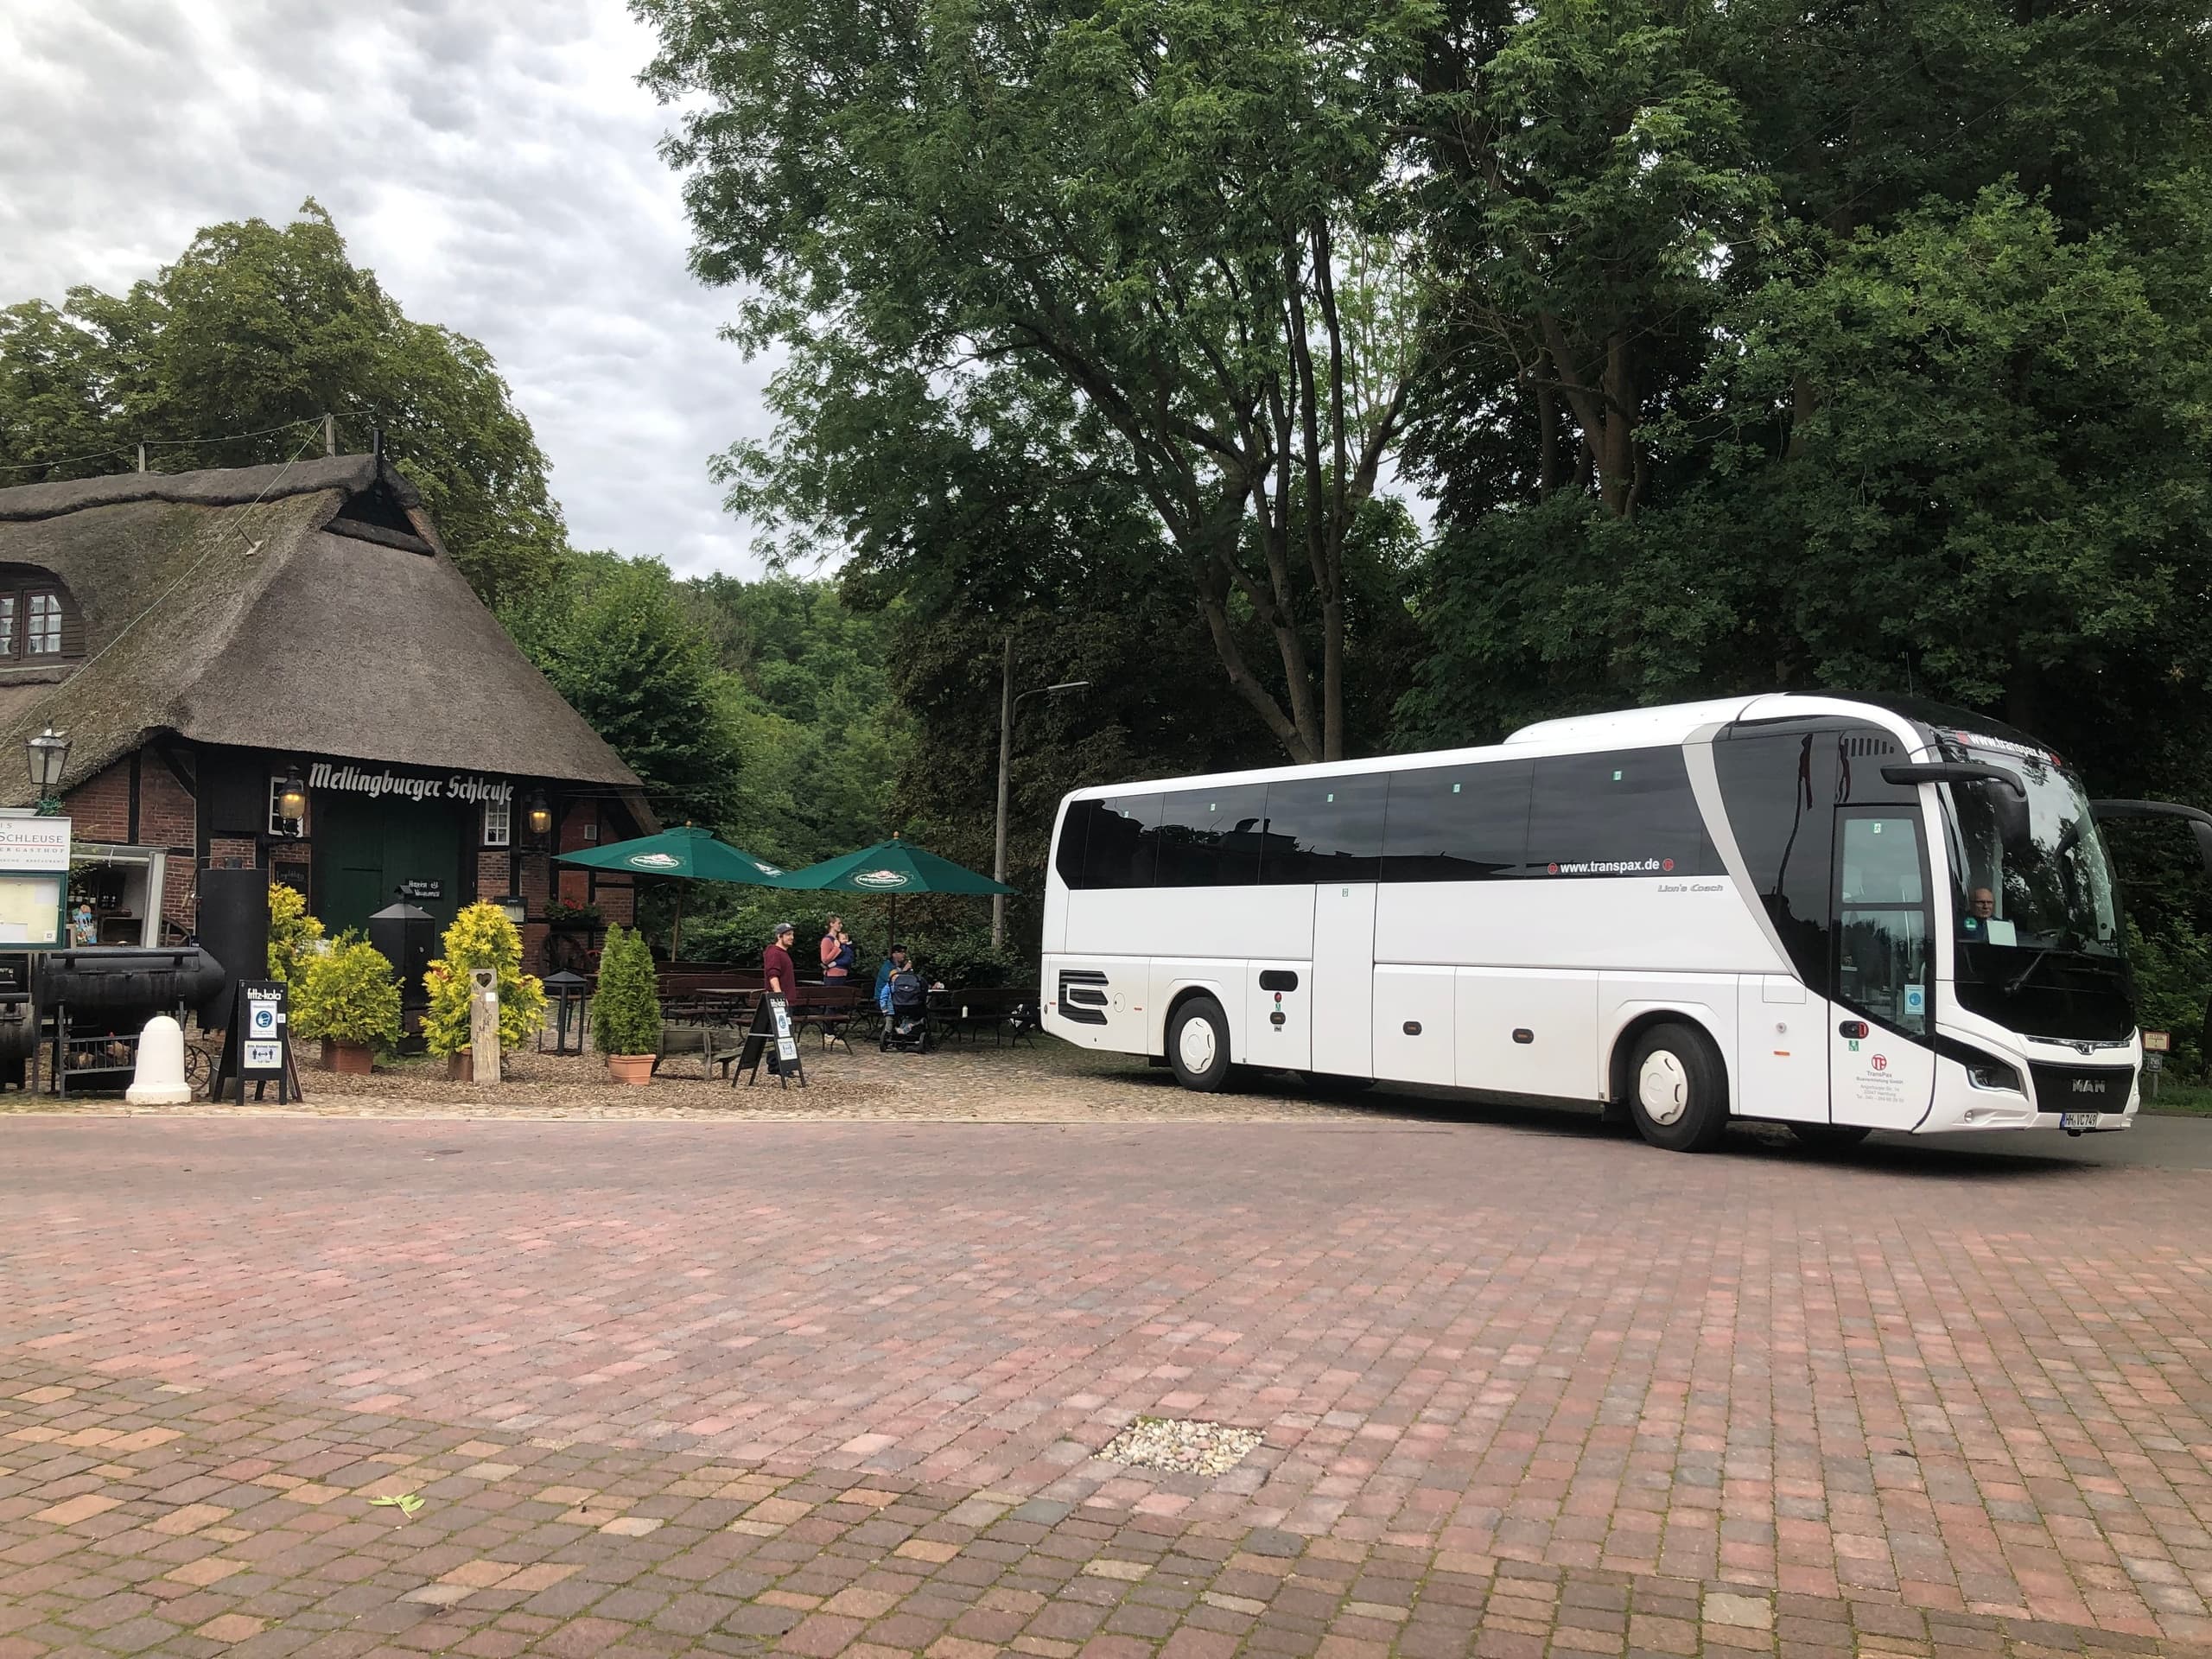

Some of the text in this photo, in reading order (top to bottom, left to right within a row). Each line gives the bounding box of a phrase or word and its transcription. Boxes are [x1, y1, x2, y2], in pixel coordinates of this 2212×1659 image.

[1967, 734, 2051, 761] www.transpax.de
[308, 762, 514, 805] Mellingburger Schleuse
[1560, 858, 1660, 874] www.transpax.de
[1657, 883, 1724, 892] Lion's Coach
[2072, 1078, 2106, 1092] MAN
